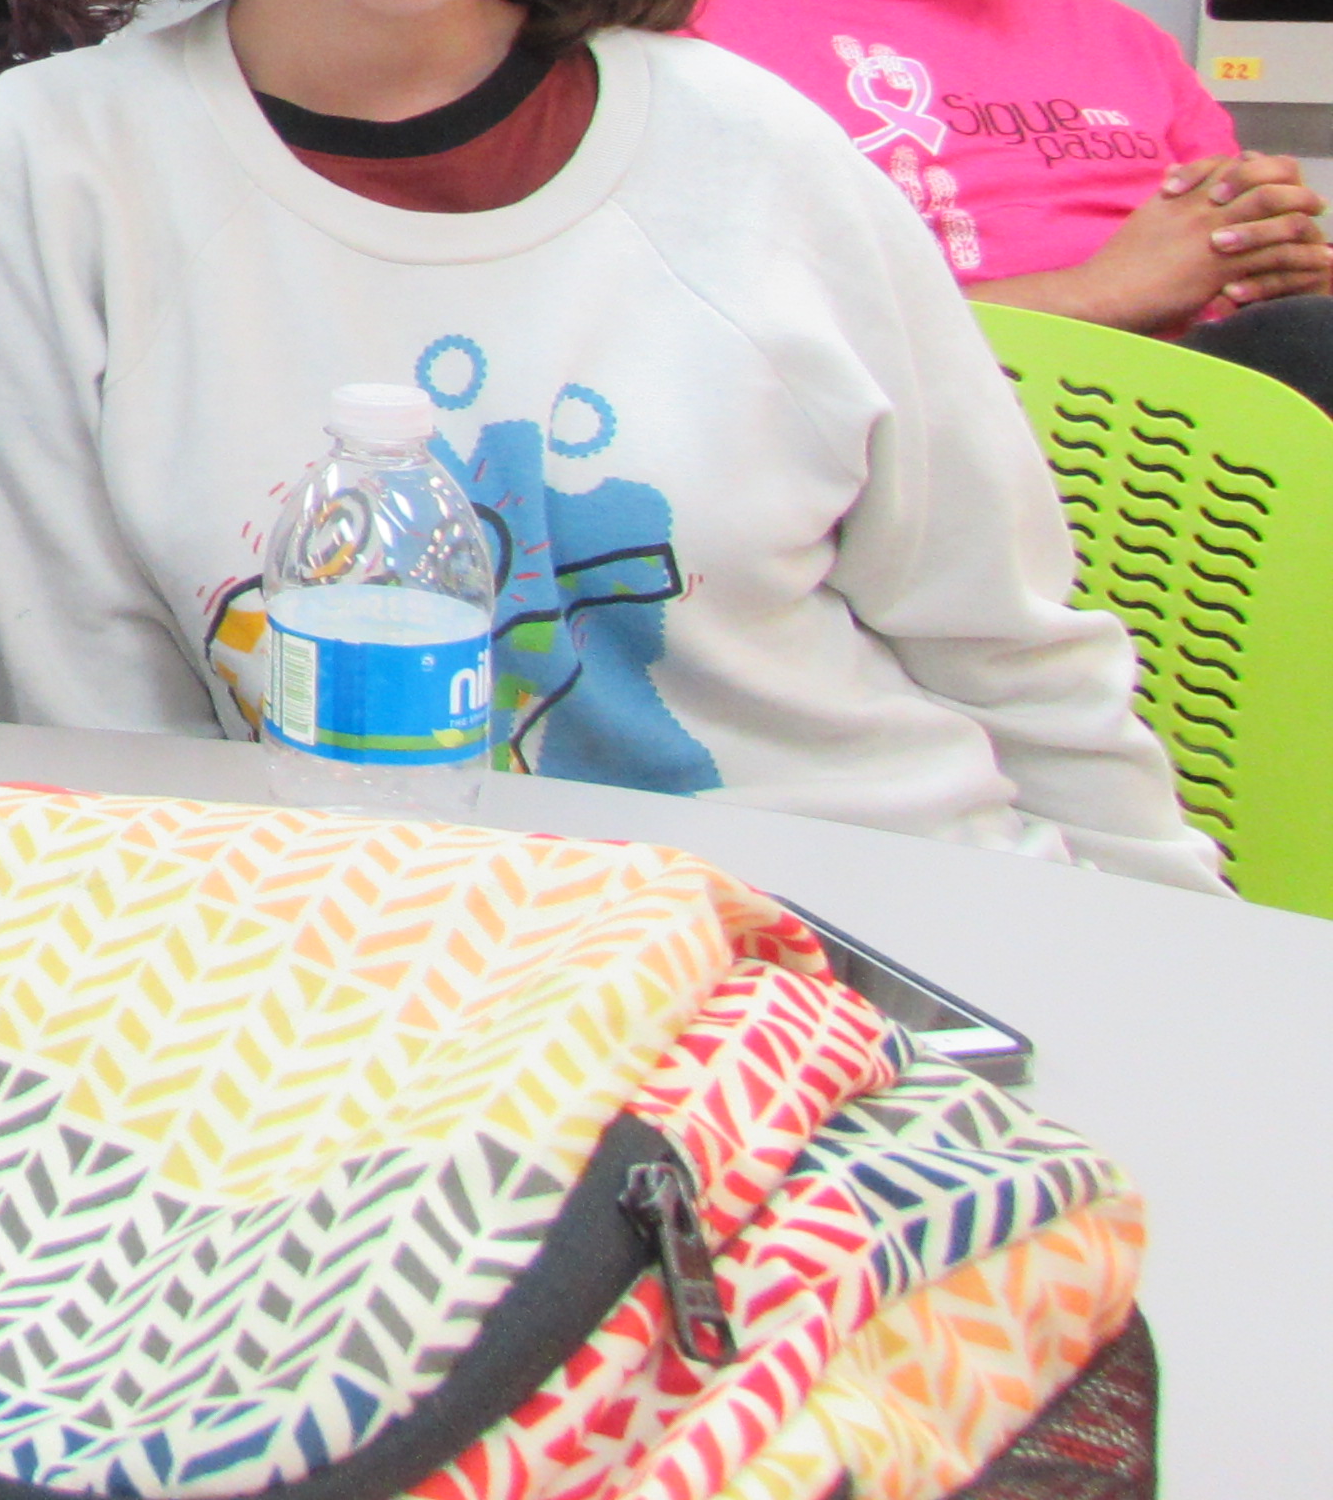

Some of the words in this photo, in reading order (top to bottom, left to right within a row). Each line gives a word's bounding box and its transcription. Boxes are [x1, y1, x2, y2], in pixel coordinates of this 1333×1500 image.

[1221, 61, 1250, 79] 22
[943, 92, 1082, 145] Sigue
[1033, 129, 1159, 169] pasos
